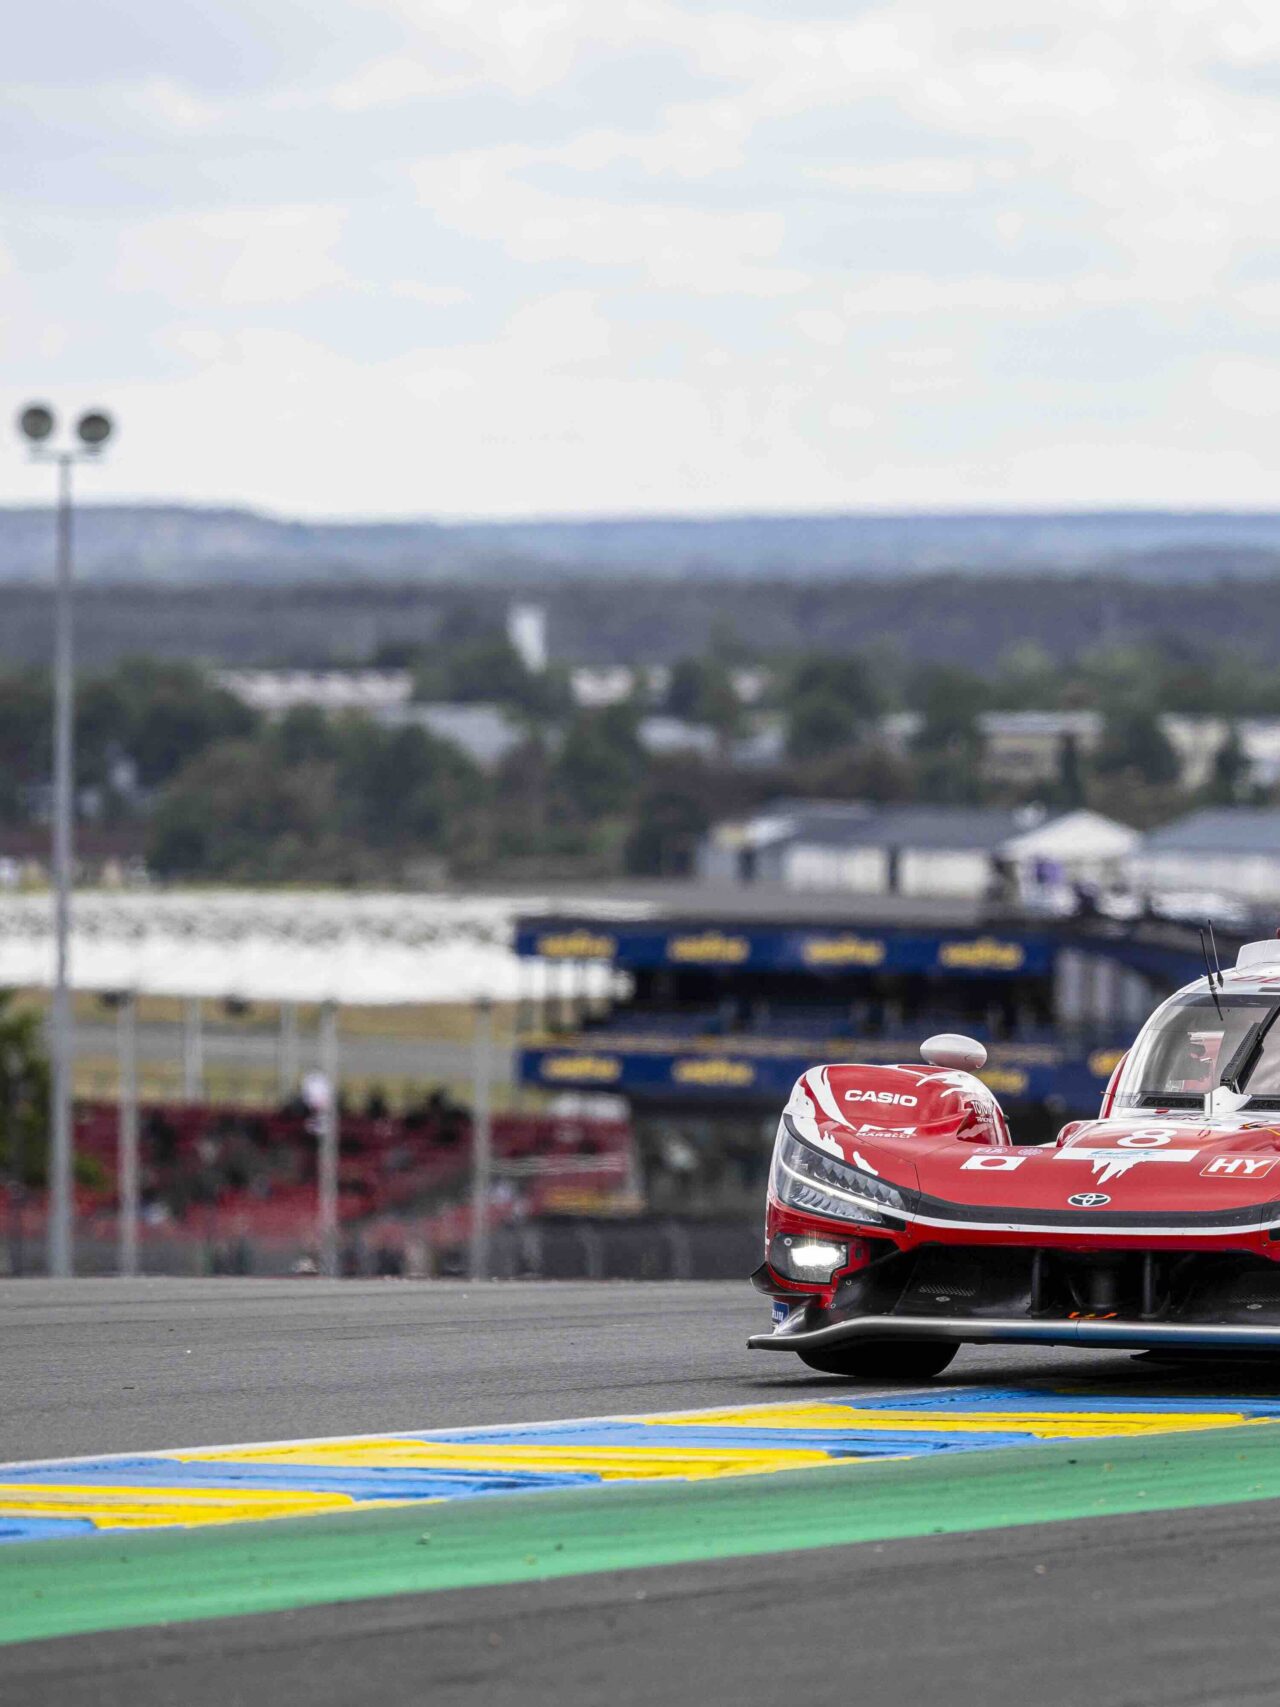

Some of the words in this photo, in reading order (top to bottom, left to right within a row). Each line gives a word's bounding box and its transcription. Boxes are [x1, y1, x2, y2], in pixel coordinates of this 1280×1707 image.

[844, 1089, 918, 1108] CASIO
[1116, 1128, 1178, 1148] 8
[1207, 1158, 1274, 1174] HY
